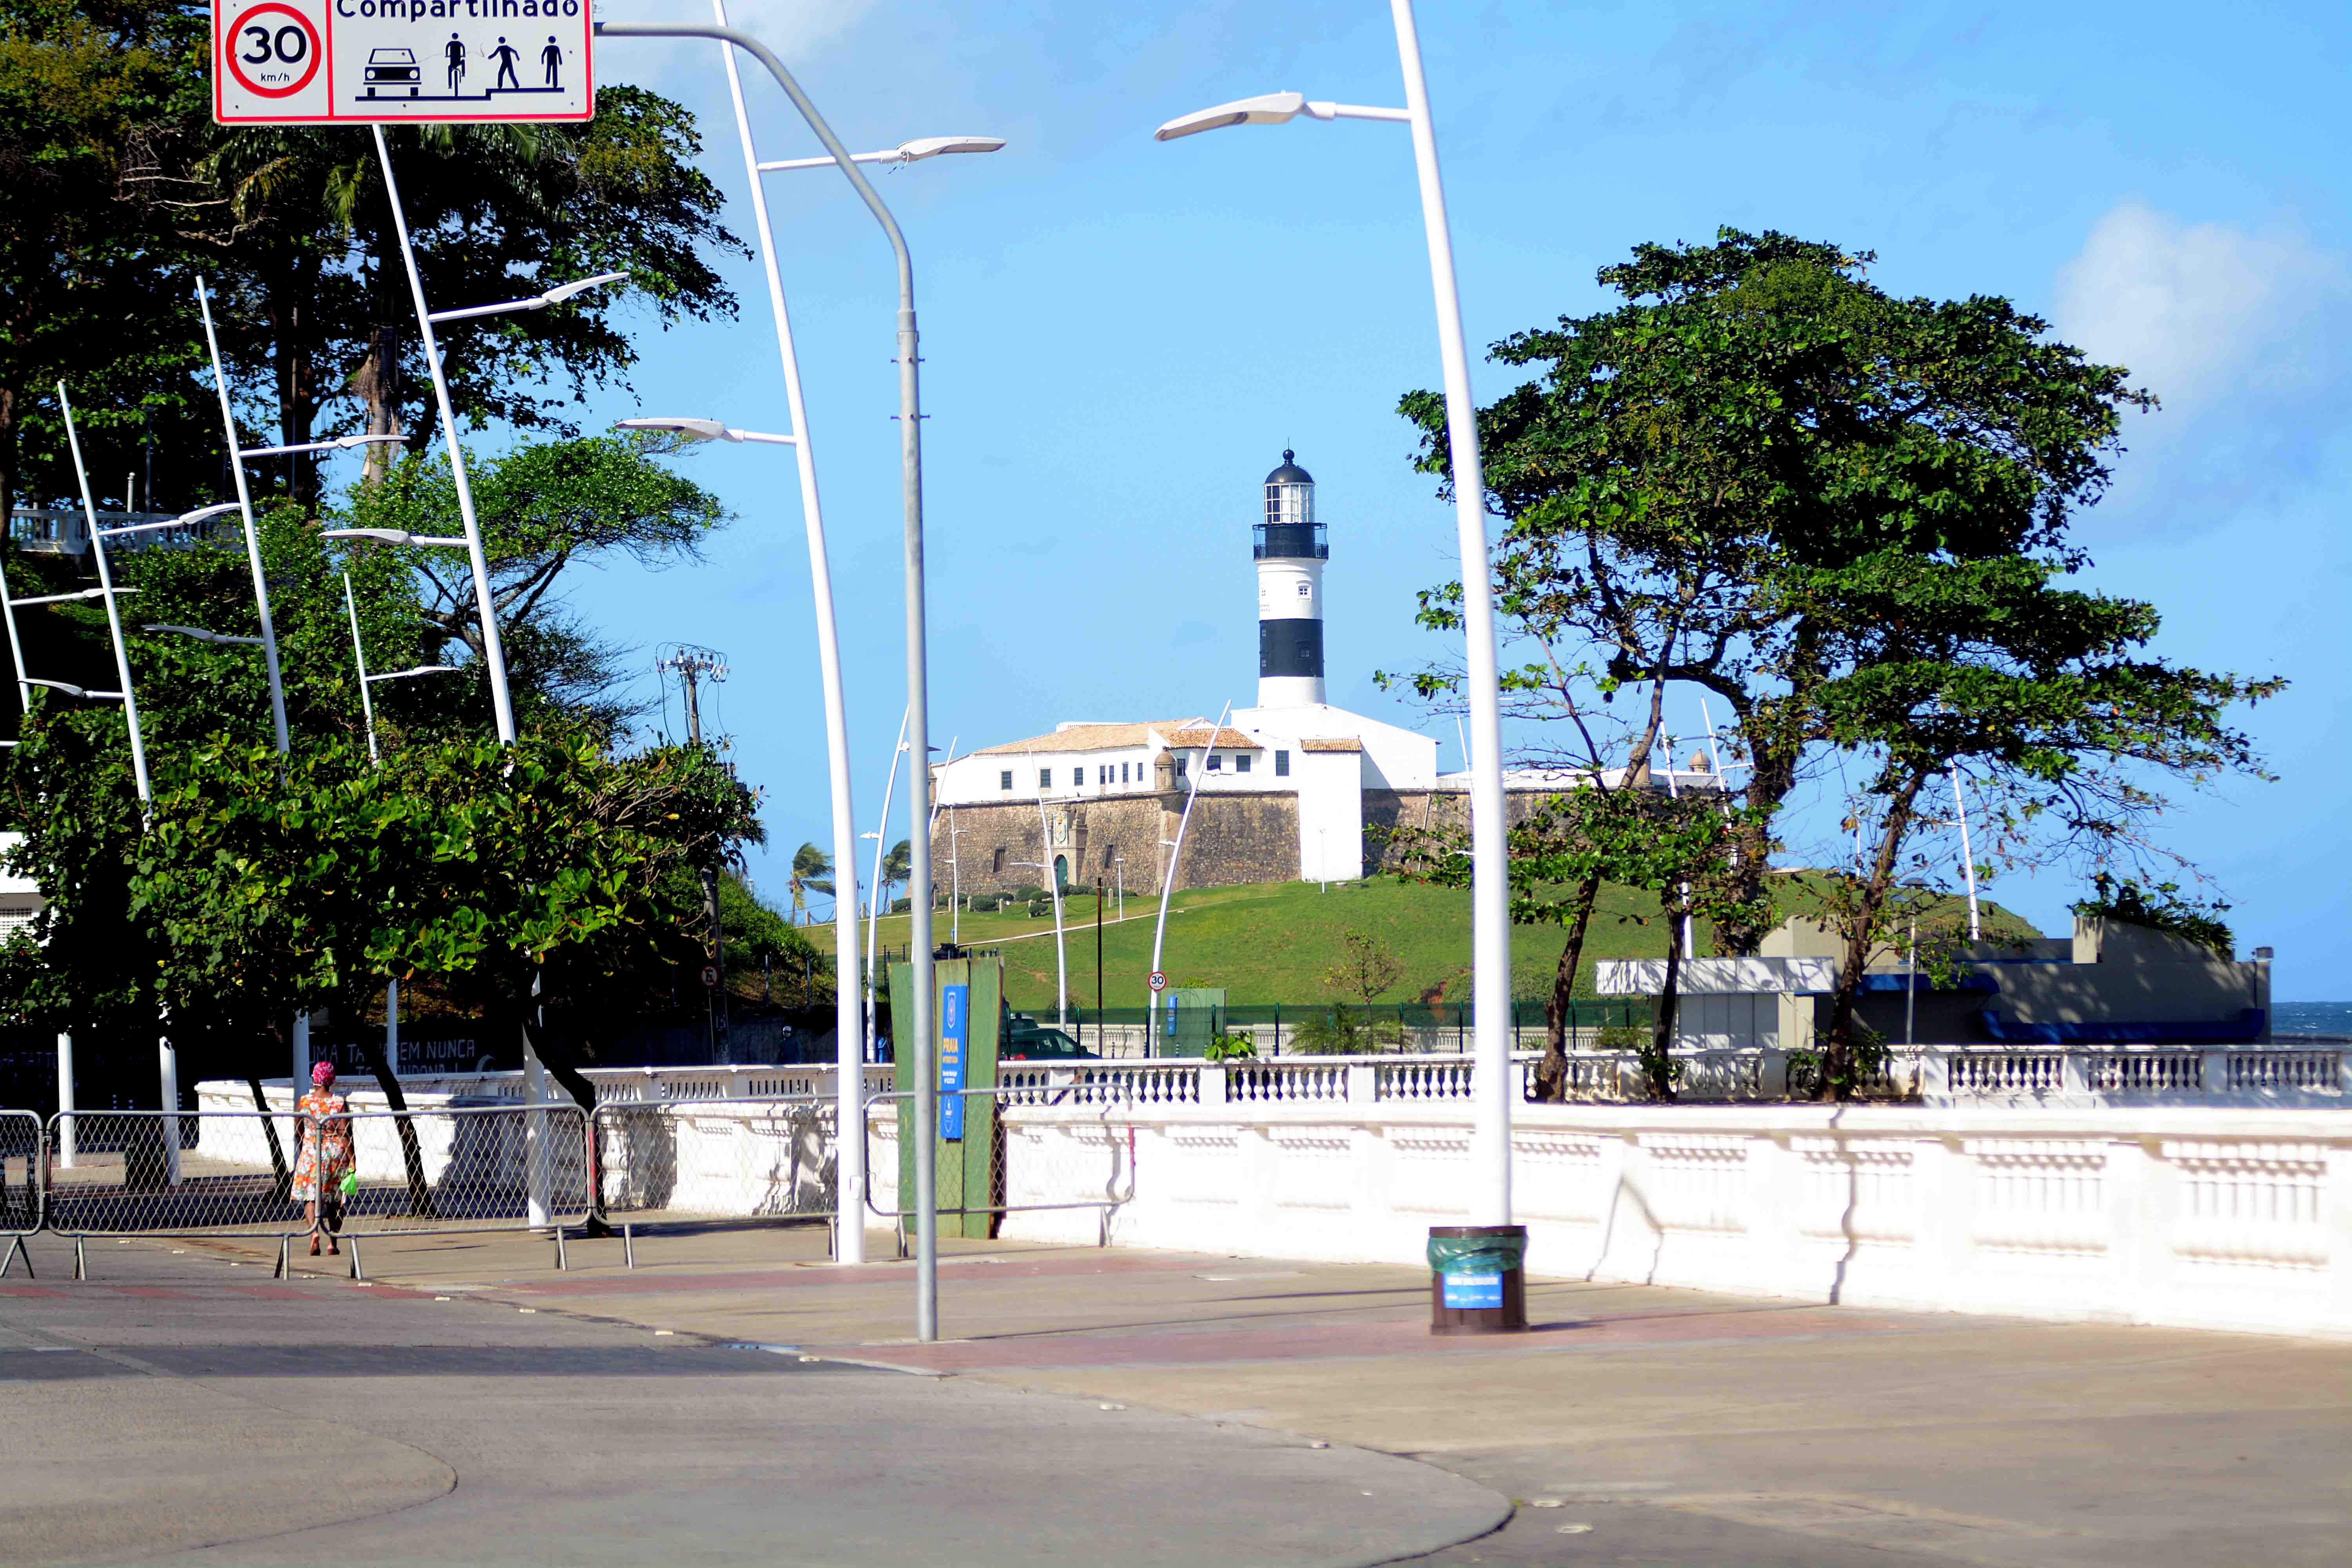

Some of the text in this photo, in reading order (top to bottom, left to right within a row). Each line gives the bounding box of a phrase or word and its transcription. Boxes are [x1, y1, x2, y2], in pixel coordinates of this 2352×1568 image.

[337, 0, 578, 23] Compartilhado
[242, 25, 307, 64] 30
[261, 73, 290, 82] km/h
[1151, 976, 1164, 984] 30
[426, 1039, 475, 1059] NUNCA
